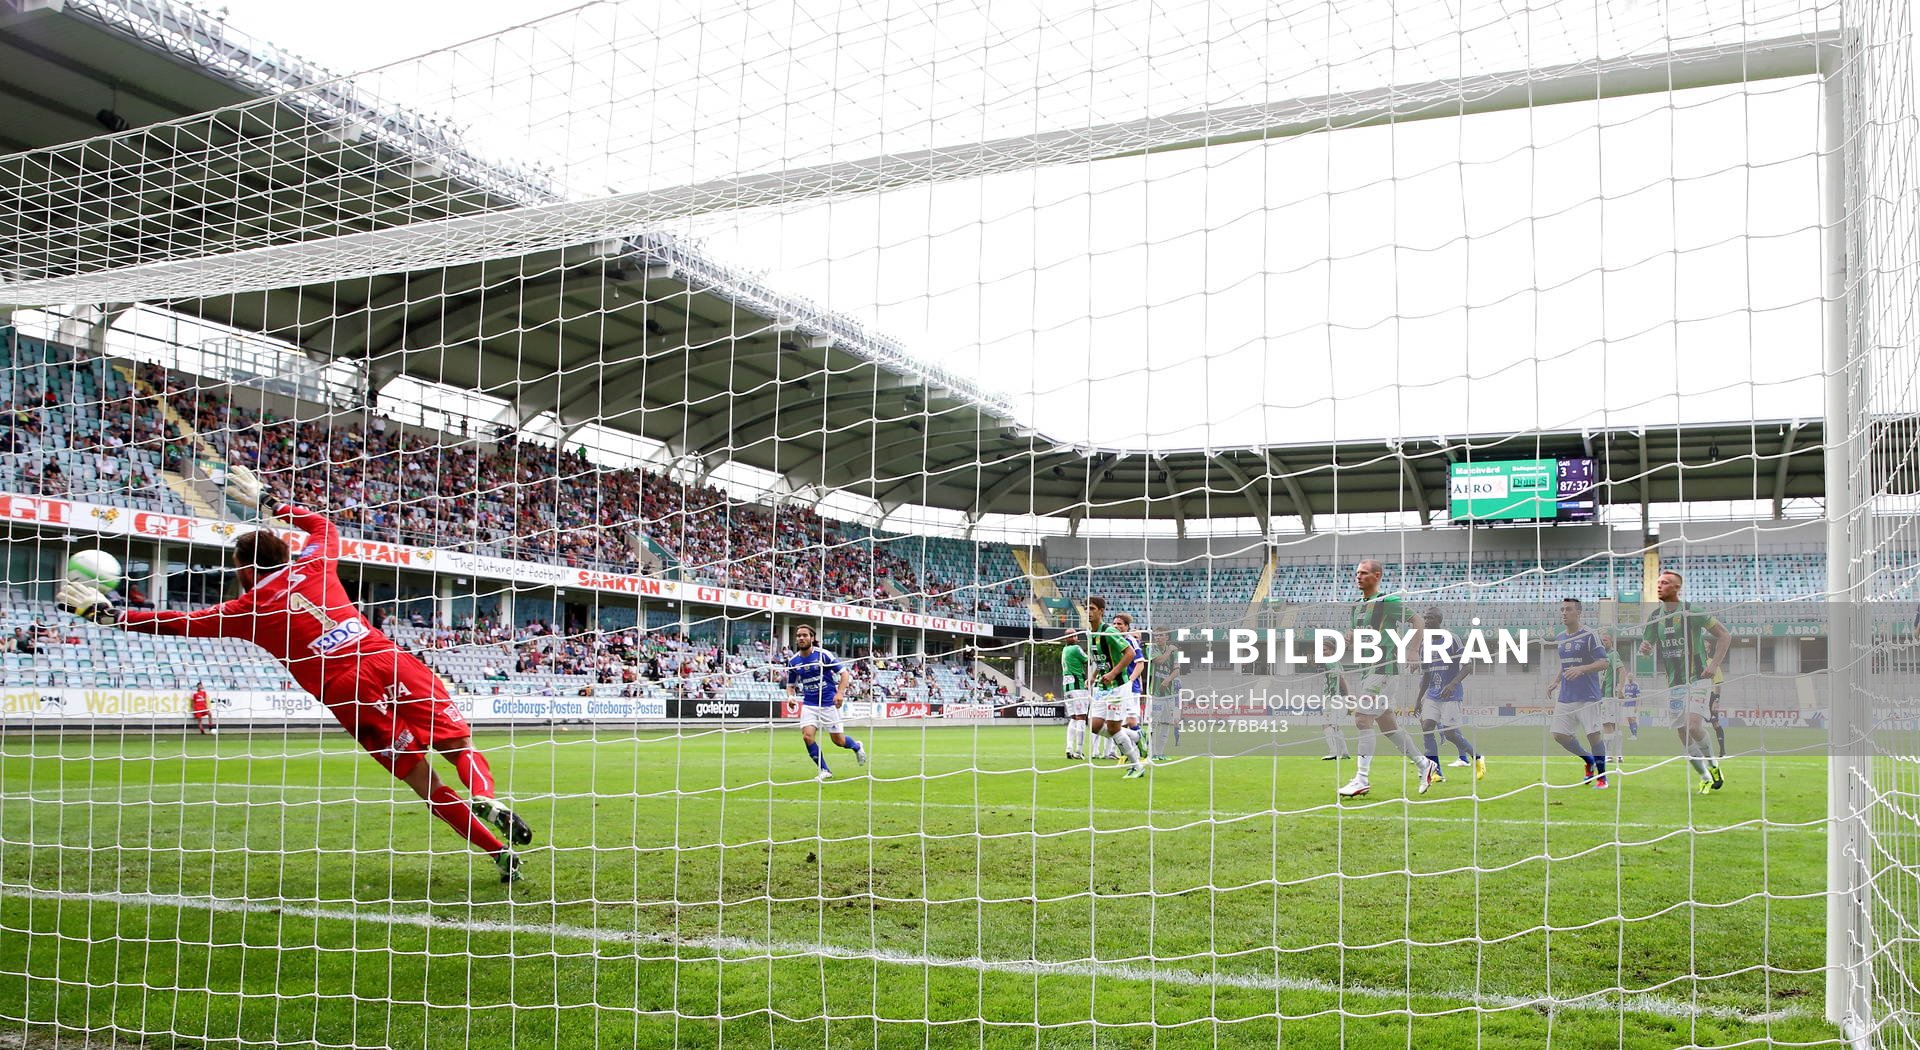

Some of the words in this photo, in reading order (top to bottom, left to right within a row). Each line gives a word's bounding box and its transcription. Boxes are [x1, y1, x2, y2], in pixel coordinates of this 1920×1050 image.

[1456, 466, 1500, 475] Machvärd
[1560, 467, 1567, 477] 3
[1583, 466, 1588, 476] 1
[1560, 481, 1589, 491] 87:32
[0, 493, 72, 524] GT
[135, 512, 198, 539] GT
[282, 532, 410, 565] SKTAN
[477, 558, 512, 575] future
[515, 563, 526, 575] of
[578, 571, 661, 595] SANKTAN
[697, 587, 723, 601] GT
[746, 593, 771, 608] GT
[291, 593, 336, 630] 1
[791, 599, 812, 614] GT
[831, 605, 851, 617] GT
[868, 609, 886, 622] GT
[901, 613, 918, 626] GT
[932, 617, 948, 630] GT
[960, 621, 975, 633] GT
[317, 618, 363, 650] BDO
[84, 690, 193, 714] Wallensta
[493, 699, 582, 717] Göteborgs-Posten
[587, 700, 664, 718] Göteborgs-Posten
[1736, 711, 1799, 719] CRAMO
[1742, 717, 1809, 727] VOLVIA
